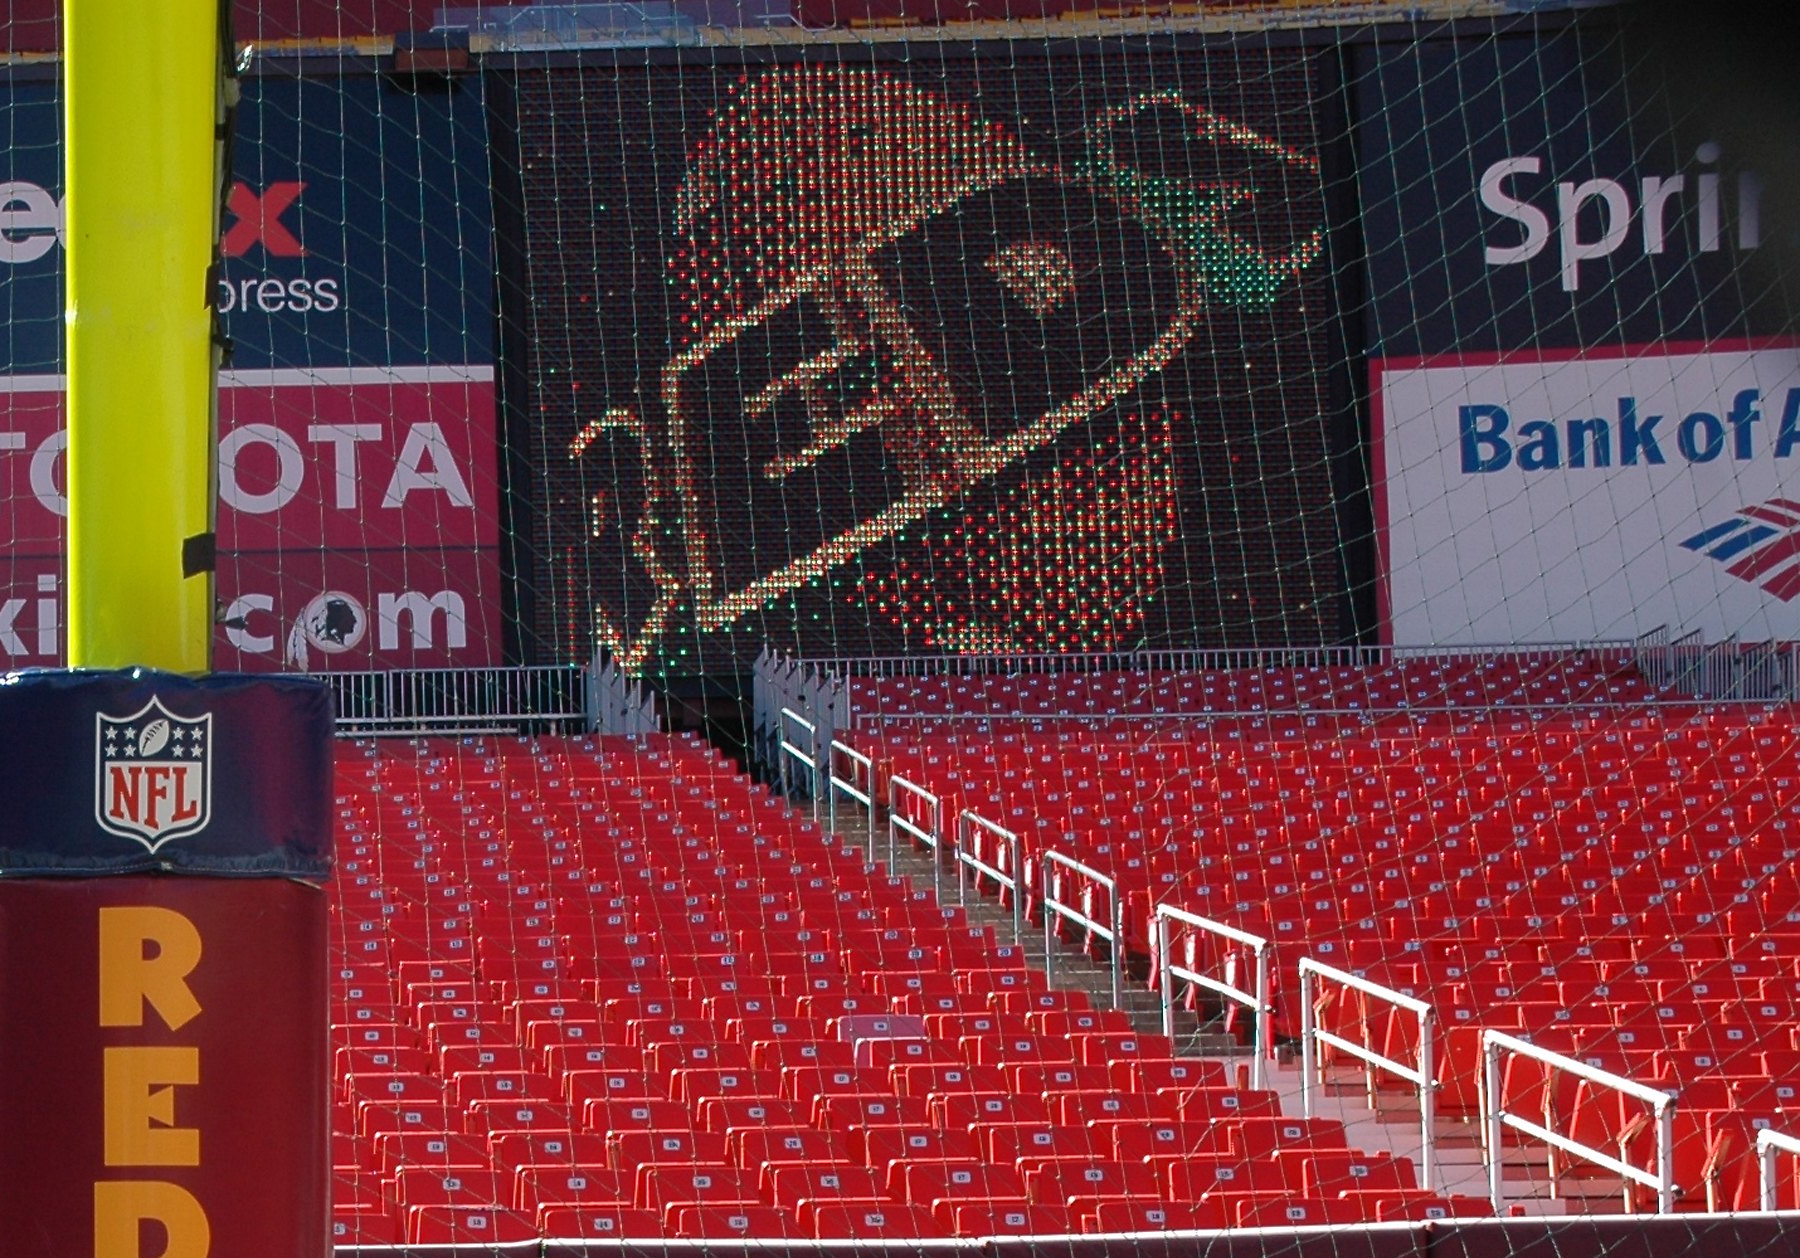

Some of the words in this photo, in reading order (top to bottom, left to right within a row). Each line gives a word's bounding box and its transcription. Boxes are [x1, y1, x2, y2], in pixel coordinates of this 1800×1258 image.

[218, 278, 339, 314] press
[1458, 397, 1666, 474] Bank
[1677, 388, 1760, 465] of
[109, 765, 198, 830] NFL
